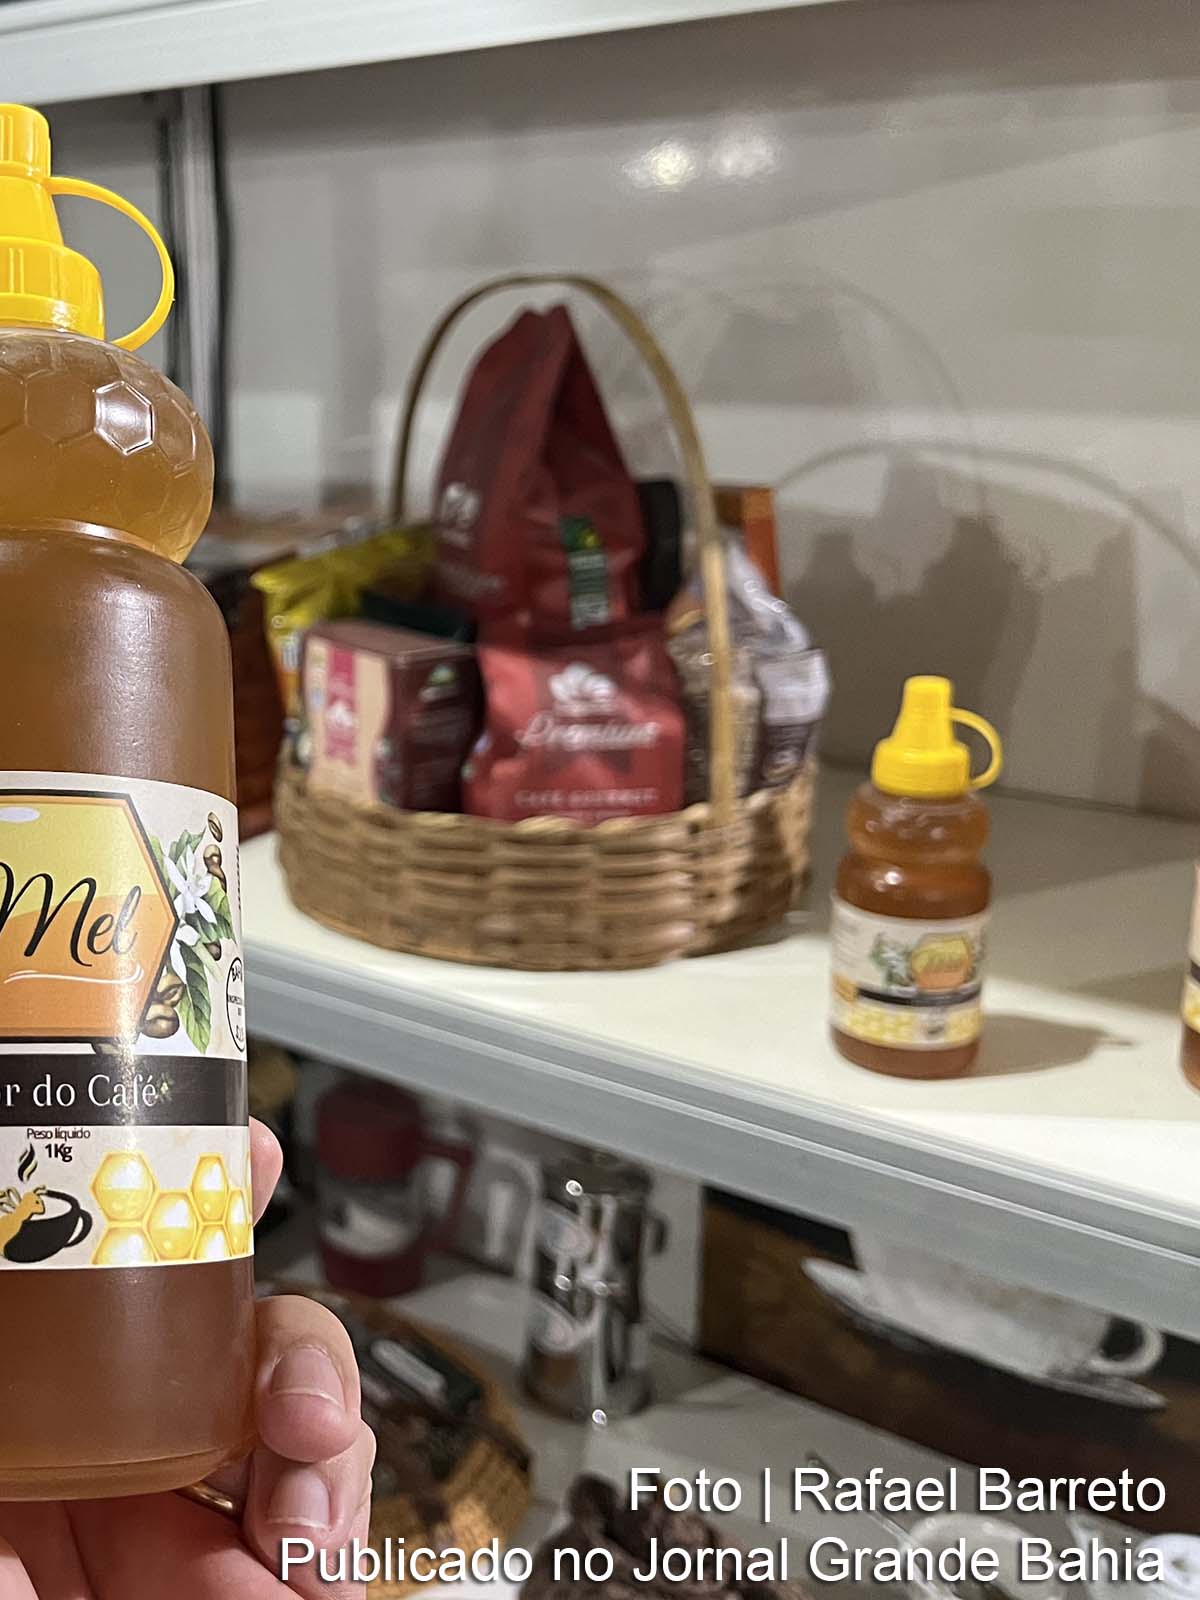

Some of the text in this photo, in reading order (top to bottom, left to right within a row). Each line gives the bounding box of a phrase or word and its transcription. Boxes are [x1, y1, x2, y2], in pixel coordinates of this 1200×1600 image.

[32, 1074, 76, 1108] do
[88, 1073, 159, 1108] Café
[26, 1126, 91, 1141] Peso líquido
[44, 1143, 73, 1163] 1Kg
